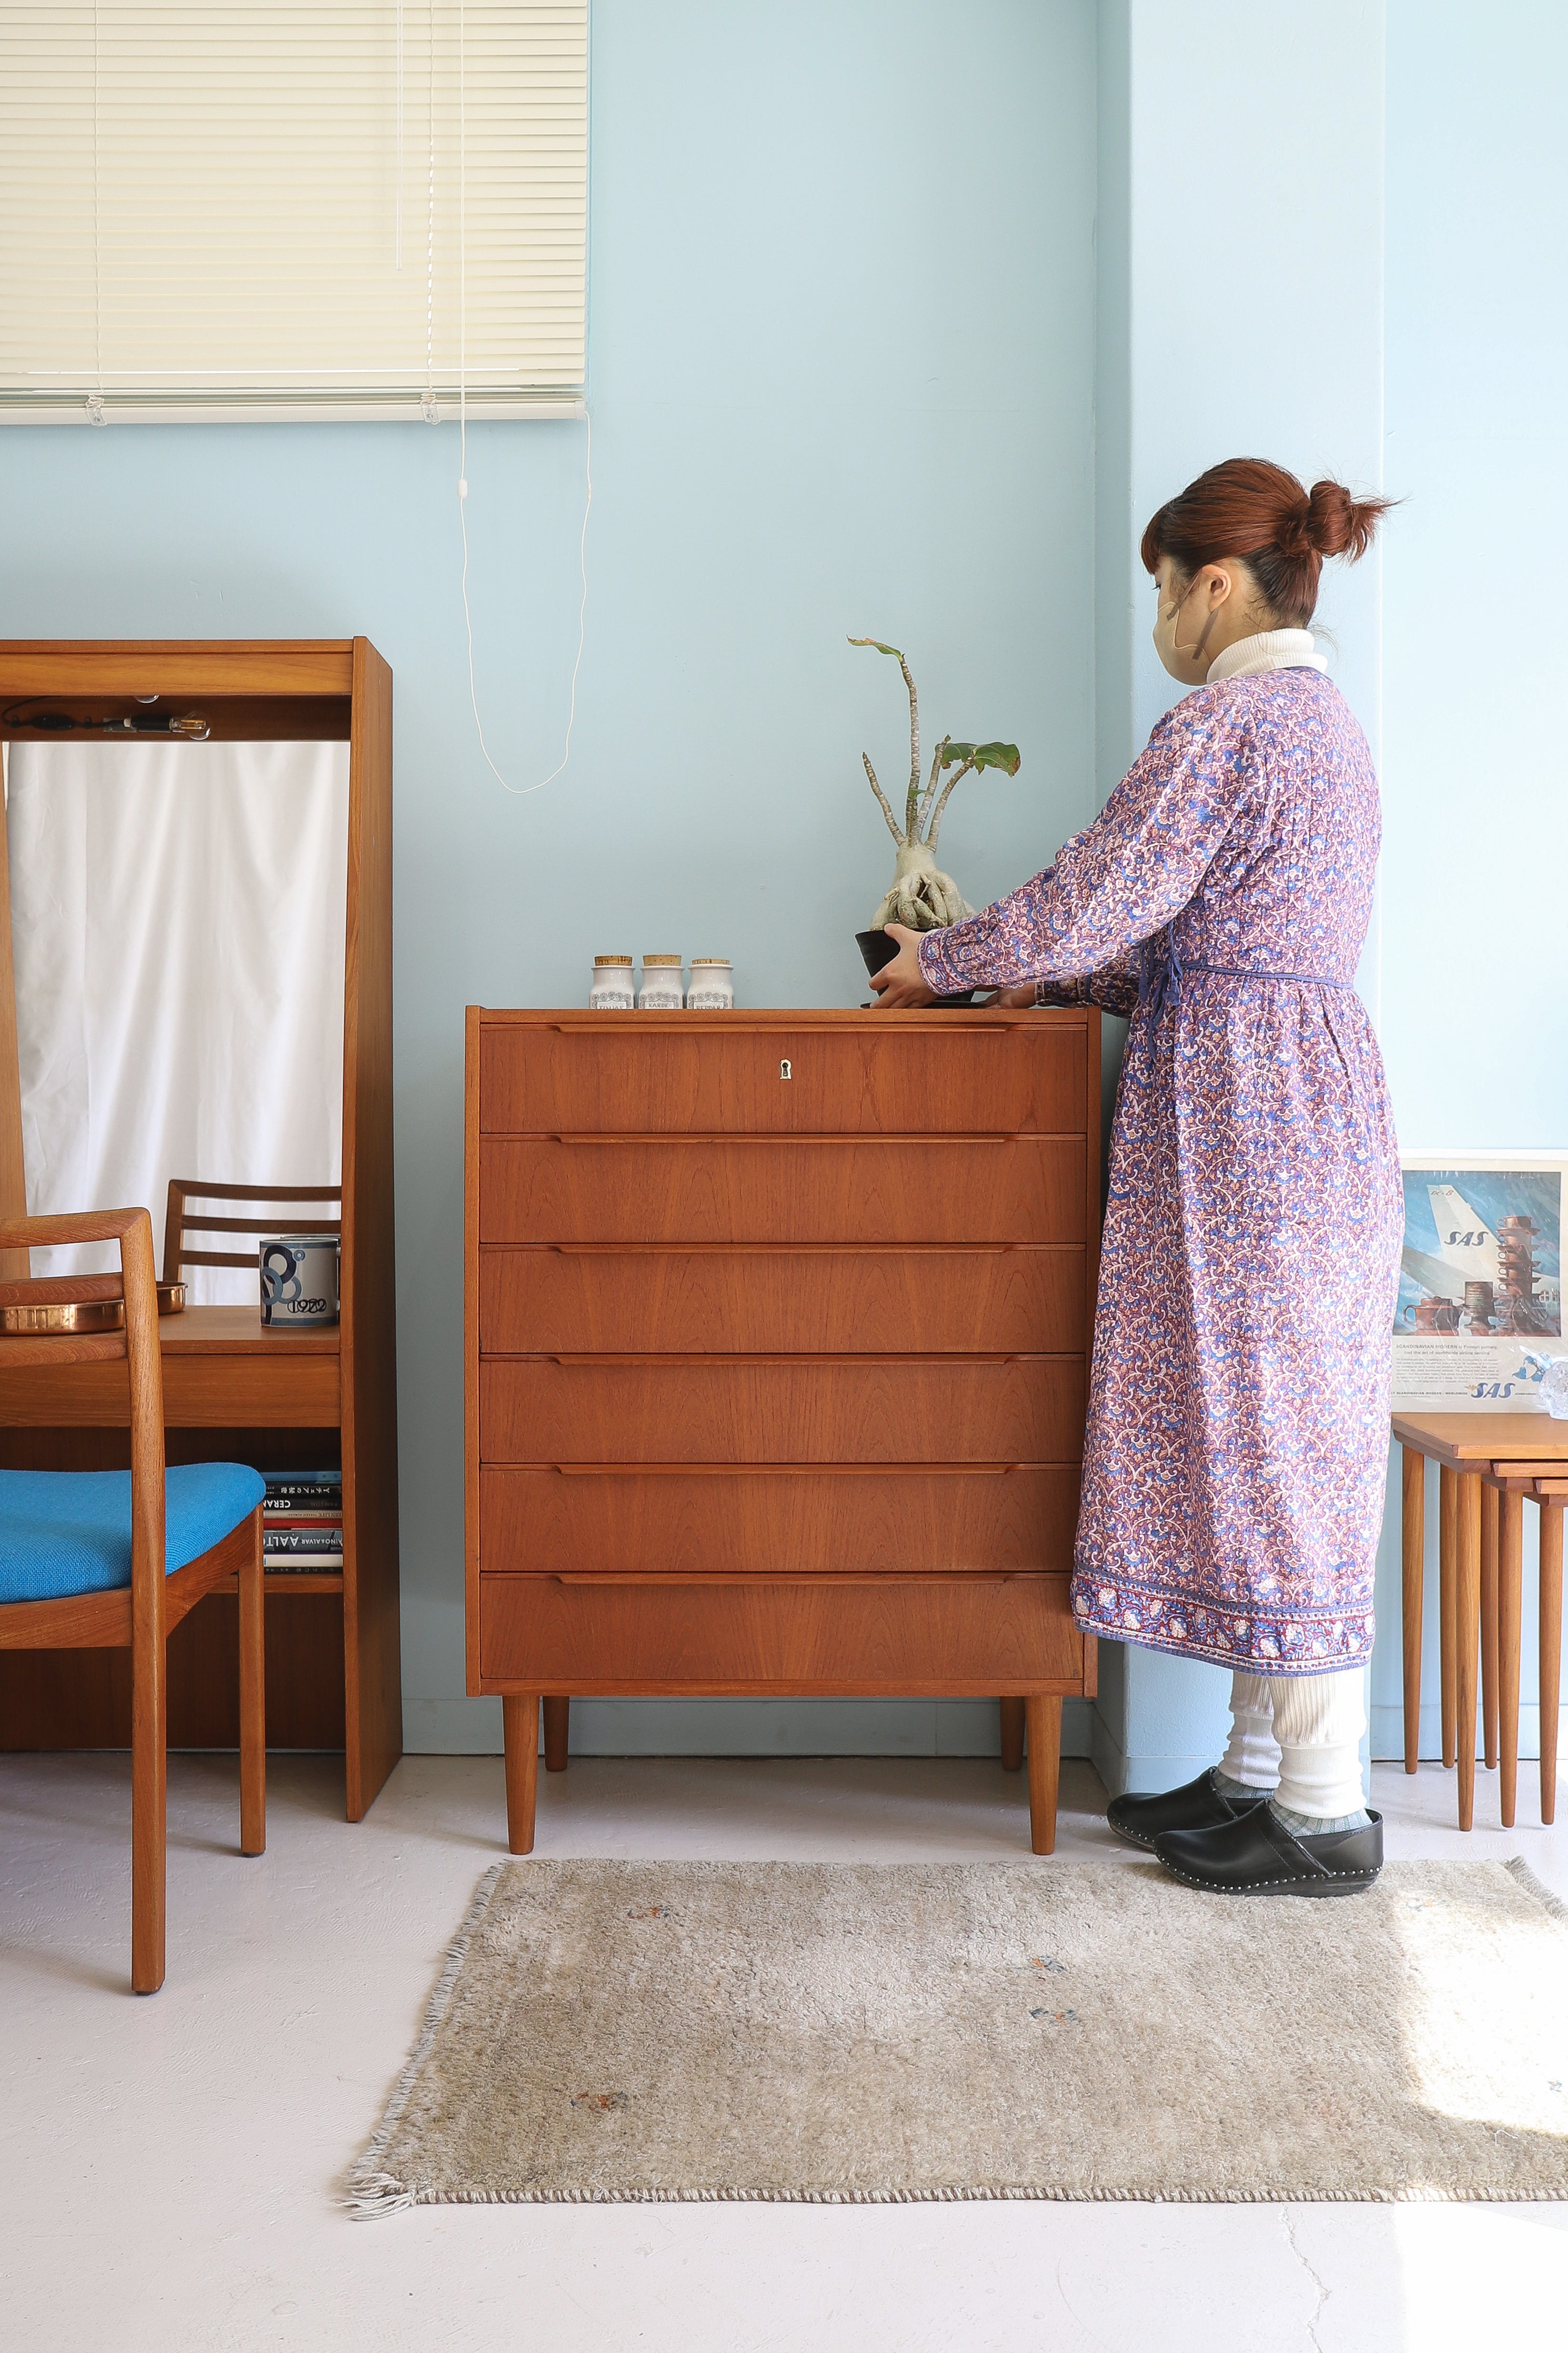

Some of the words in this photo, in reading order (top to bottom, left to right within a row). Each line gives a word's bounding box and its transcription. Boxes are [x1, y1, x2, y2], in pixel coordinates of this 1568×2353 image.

[1444, 1231, 1489, 1246] SAS
[287, 1298, 327, 1313] 1972
[1471, 1382, 1515, 1399] SAS
